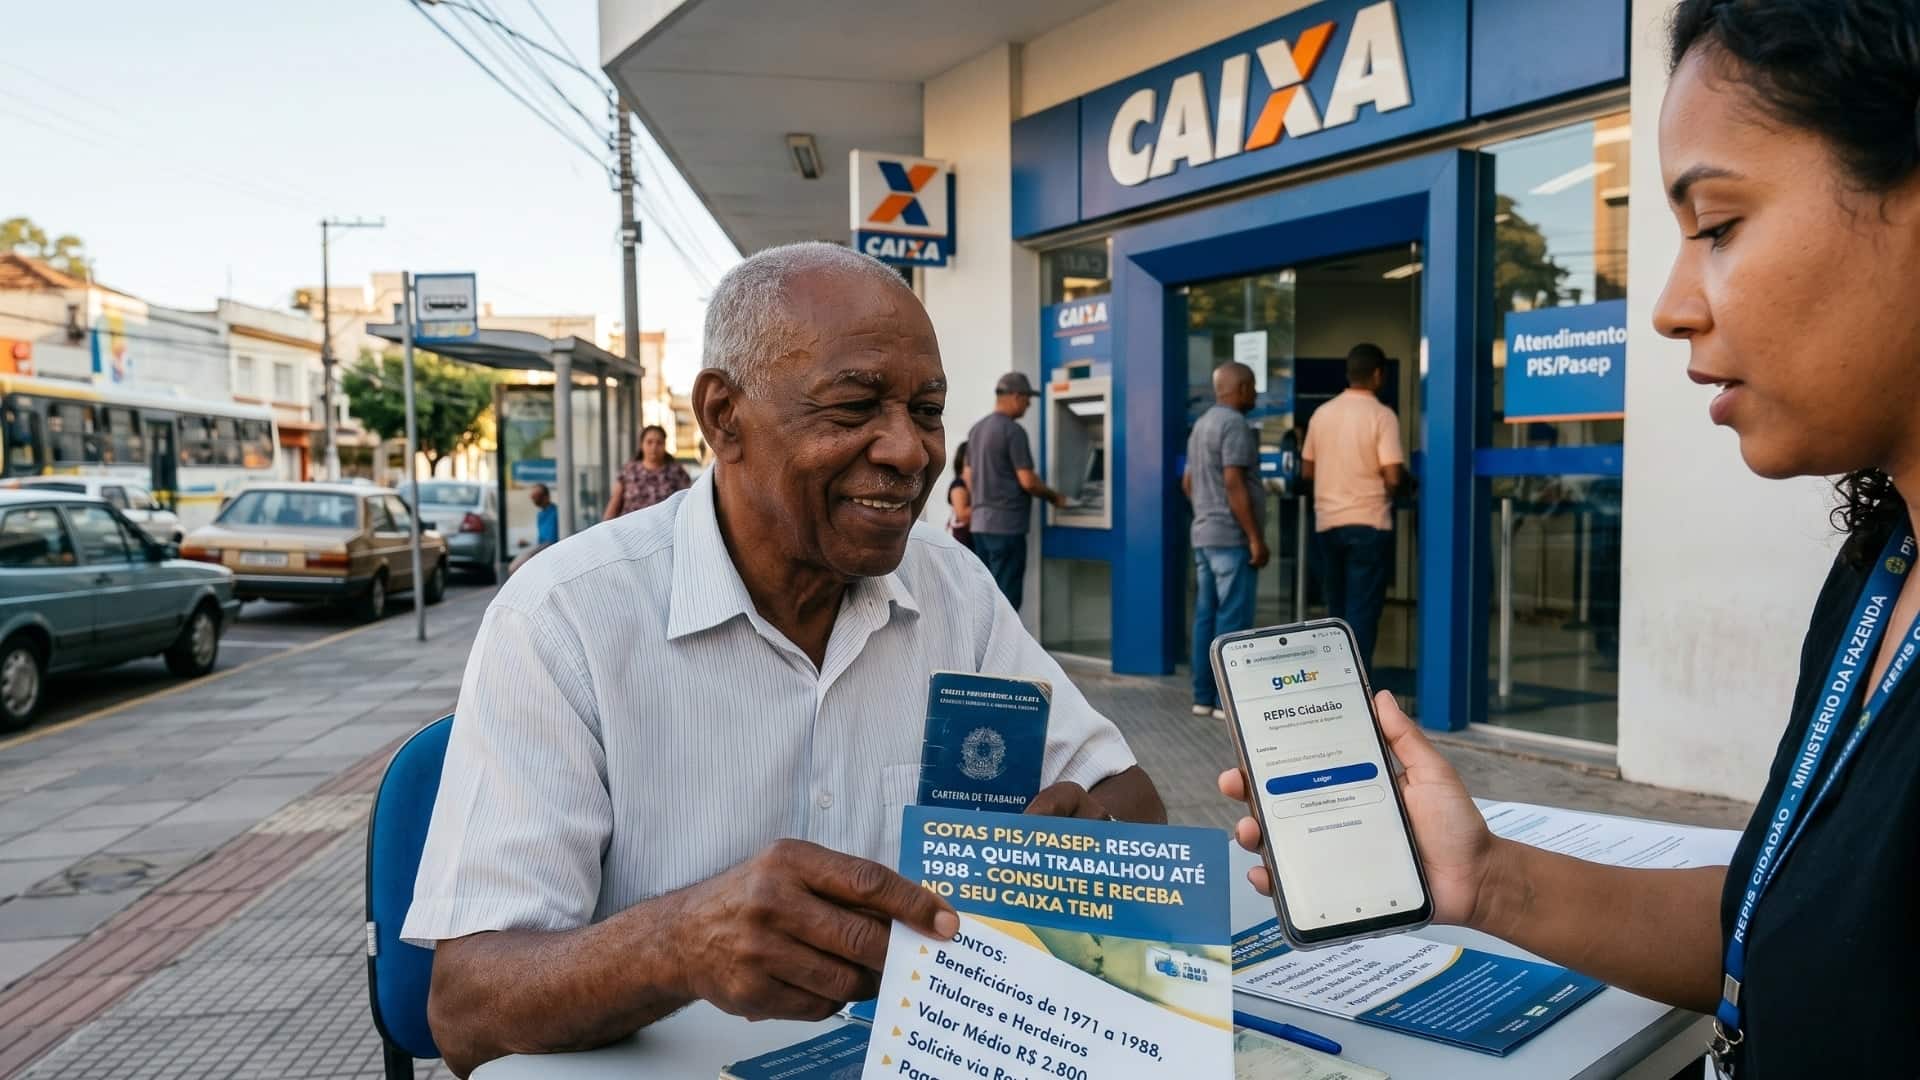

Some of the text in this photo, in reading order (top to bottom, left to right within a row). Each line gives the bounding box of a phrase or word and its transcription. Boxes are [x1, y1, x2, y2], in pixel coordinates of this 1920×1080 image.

[1108, 0, 1412, 186] CAIXA
[865, 236, 940, 261] CAIXA
[1058, 302, 1107, 328] CAIXA
[1513, 326, 1627, 353] Atendimento
[1526, 355, 1611, 377] PIS/Pasep
[1882, 642, 1915, 694] REPIS
[1263, 701, 1343, 721] REPIS Cidadão
[1734, 889, 1756, 943] REPIS
[1753, 808, 1789, 885] CIDADÃO
[1792, 694, 1840, 789] MINISTÉRIO
[1832, 669, 1854, 693] DA
[1843, 595, 1888, 667] FAZENDA
[931, 789, 1027, 805] CARTEIRA DE TRABALHO
[923, 822, 1191, 861] COTAS PIS/PASEP: RESGATE
[923, 841, 1205, 885] PARA QUEM TRABALHOU ATÉ
[923, 860, 969, 878] 1988
[987, 867, 1088, 895] CONSULTE
[1093, 881, 1104, 897] E
[1109, 883, 1184, 905] RECEBA
[921, 879, 1113, 920] NO SEU CAIXA TEM!
[952, 932, 1007, 964] ONTOS:
[929, 975, 1088, 1057] Titulares e Herdeiros
[936, 950, 1163, 1062] Beneficiários de 1971 a 1988,
[907, 1031, 962, 1066] Solicite
[966, 1058, 989, 1078] via
[918, 1001, 960, 1032] Valor
[963, 1023, 1011, 1056] Médio
[1016, 1045, 1038, 1066] R$
[1041, 1055, 1088, 1080] 2.800
